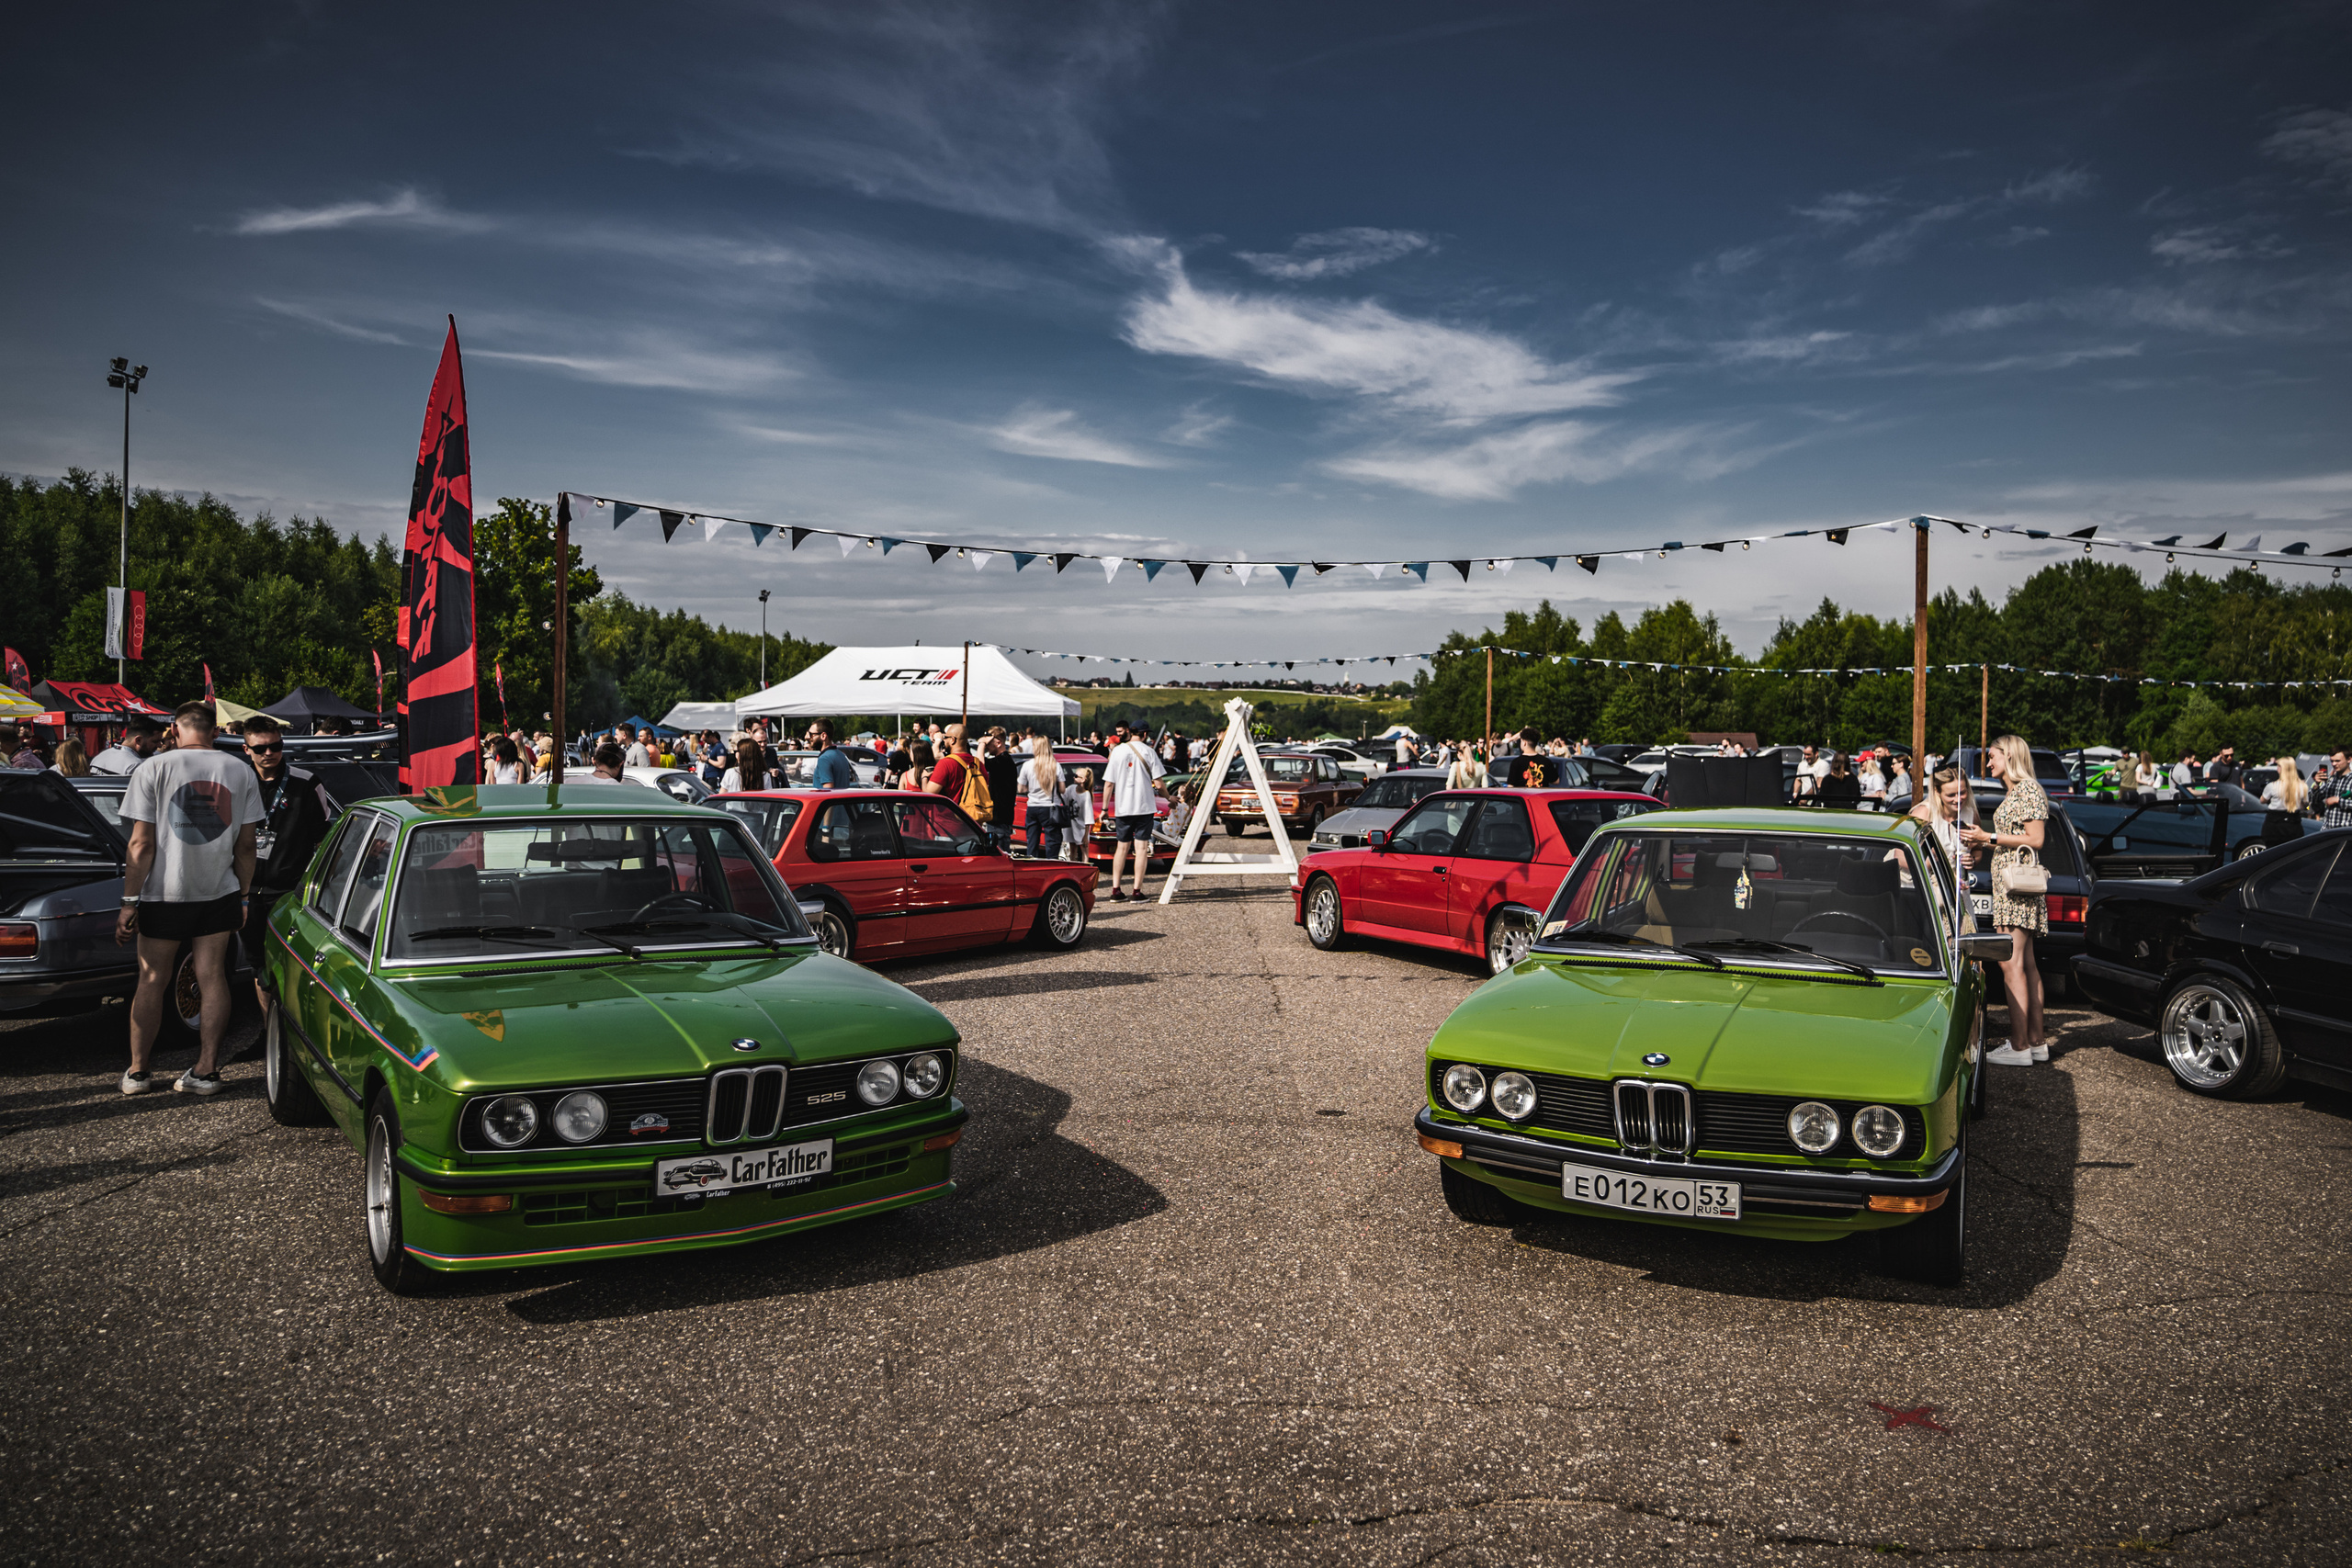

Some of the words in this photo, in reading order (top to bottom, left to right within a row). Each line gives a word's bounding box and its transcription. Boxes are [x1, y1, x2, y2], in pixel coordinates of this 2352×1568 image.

[807, 1090, 846, 1106] 525
[1699, 1184, 1729, 1207] 53
[1696, 1205, 1720, 1215] RUS
